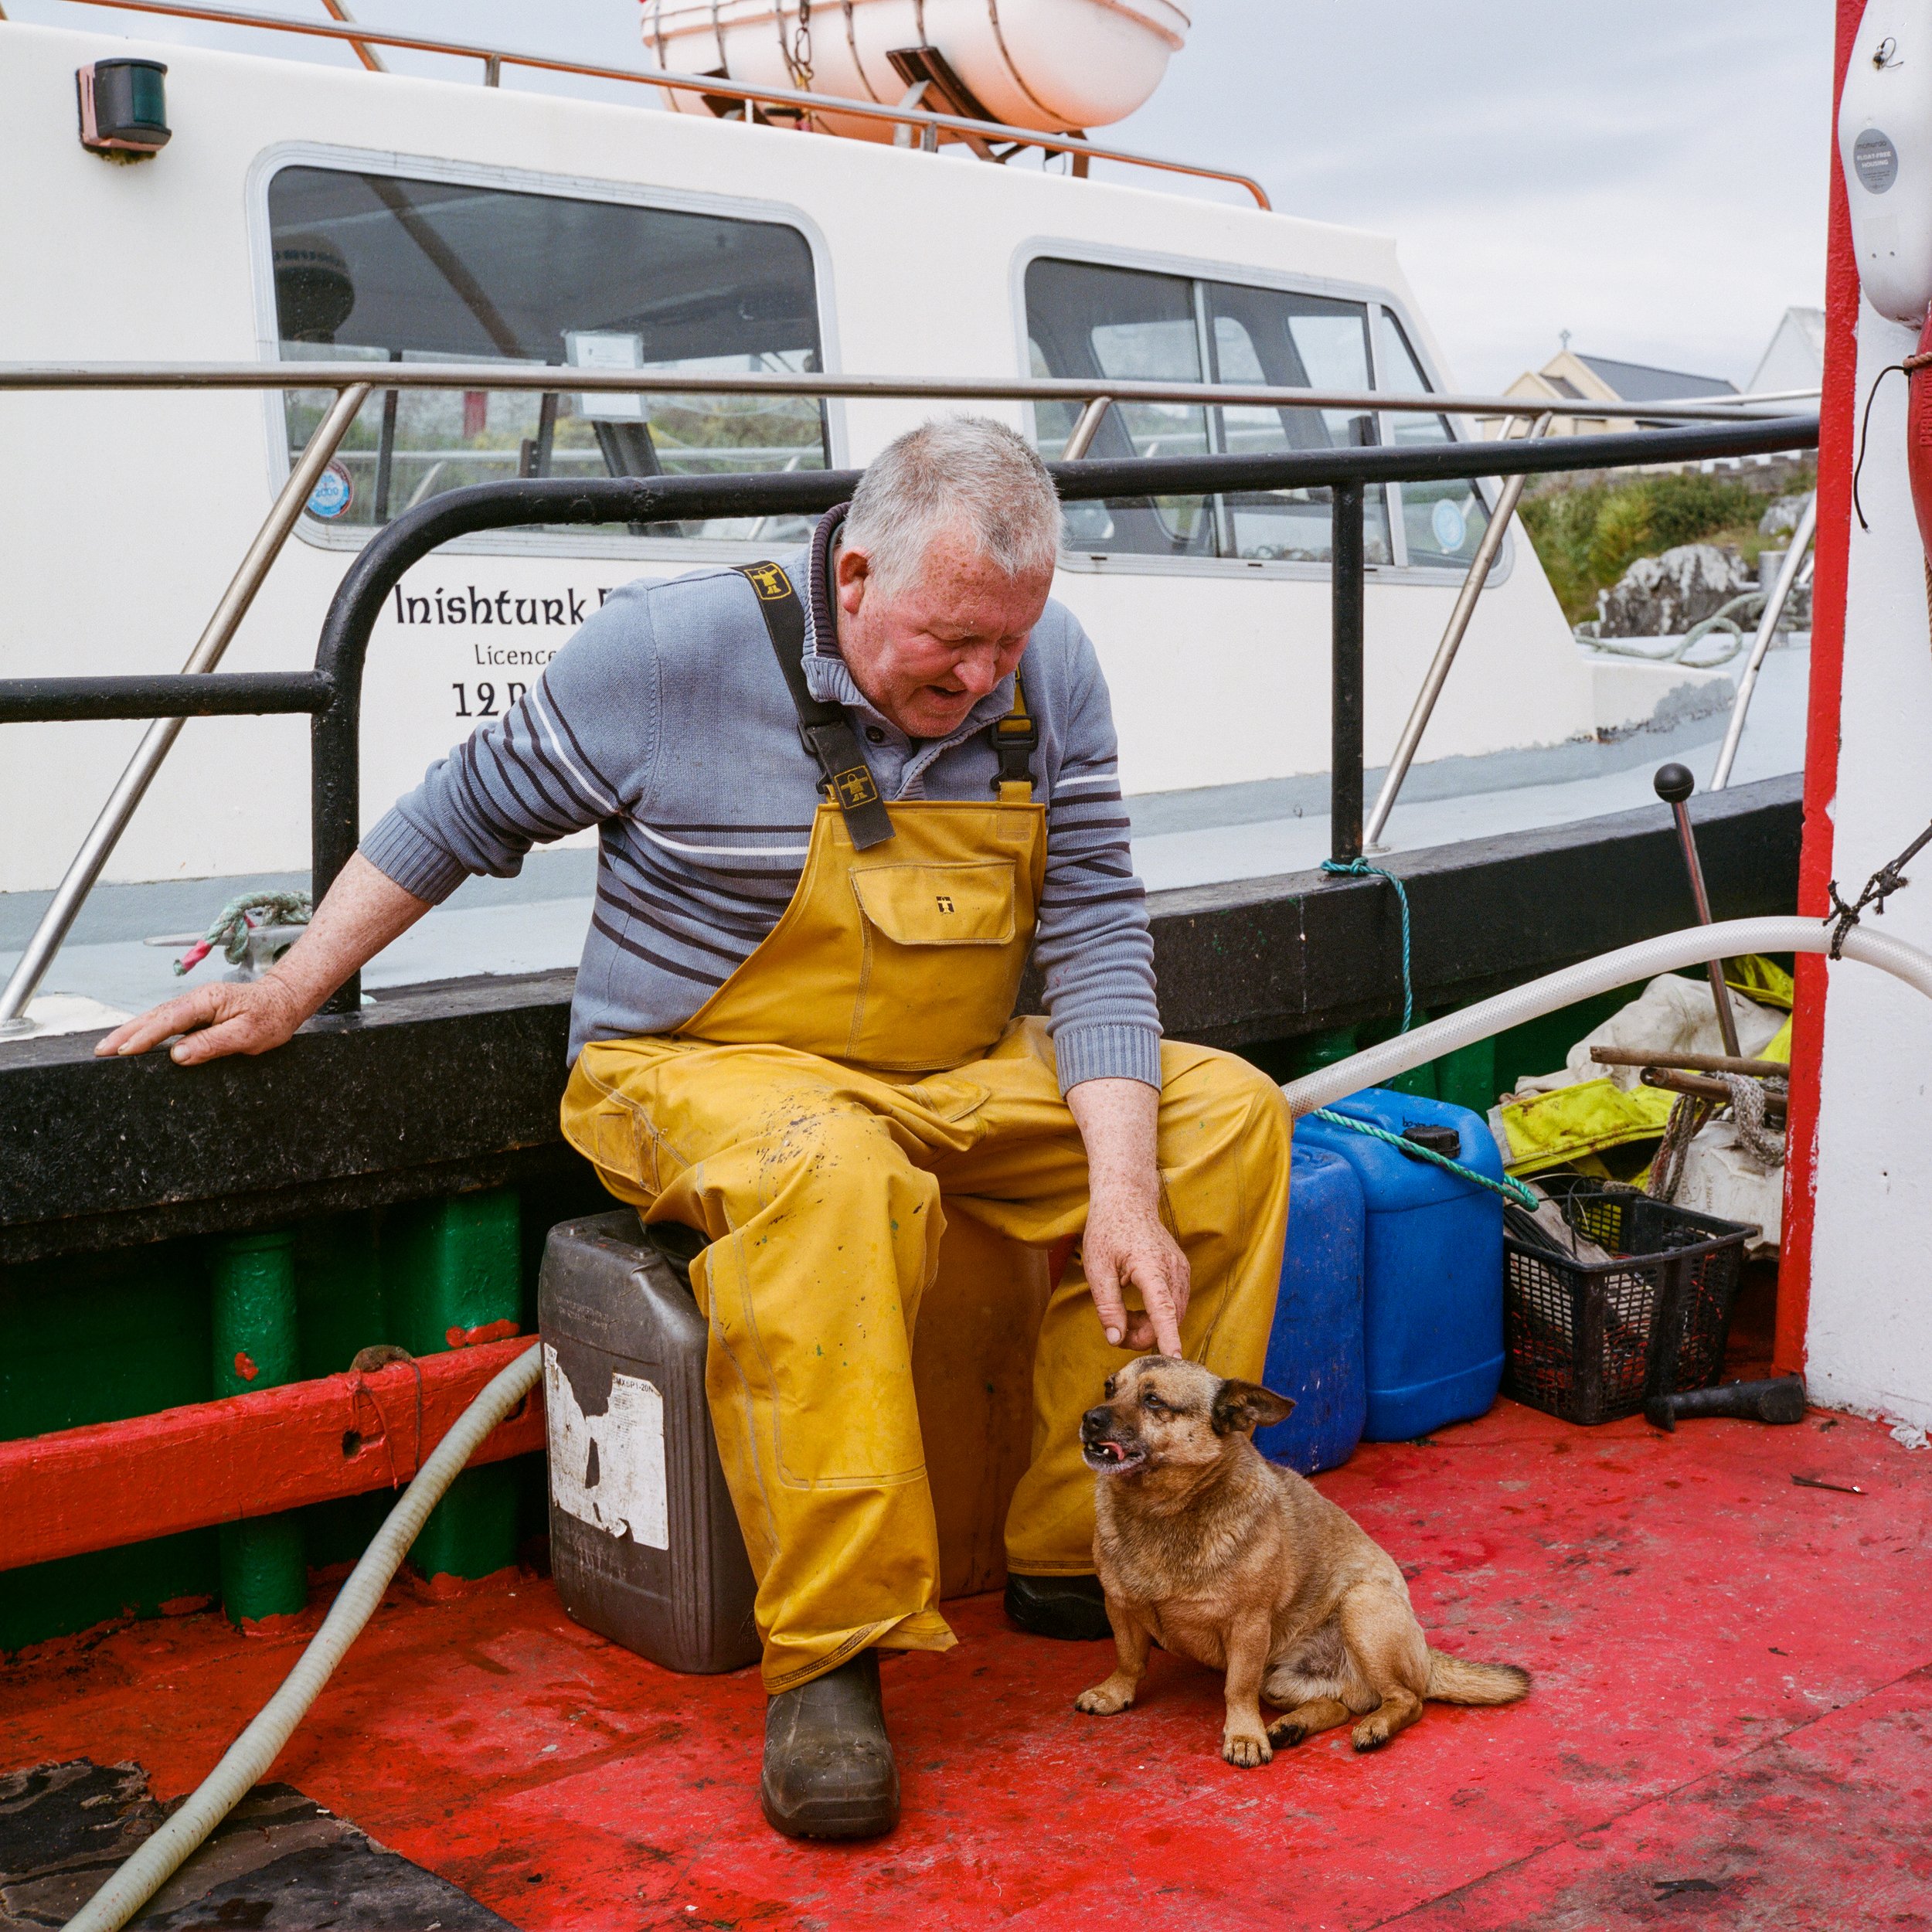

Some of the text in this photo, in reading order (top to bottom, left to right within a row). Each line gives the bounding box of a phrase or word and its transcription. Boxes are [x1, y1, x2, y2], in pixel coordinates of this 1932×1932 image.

[1856, 151, 1892, 160] FLOAT-FREE
[394, 583, 587, 626] Inishturk
[452, 682, 500, 717] 12
